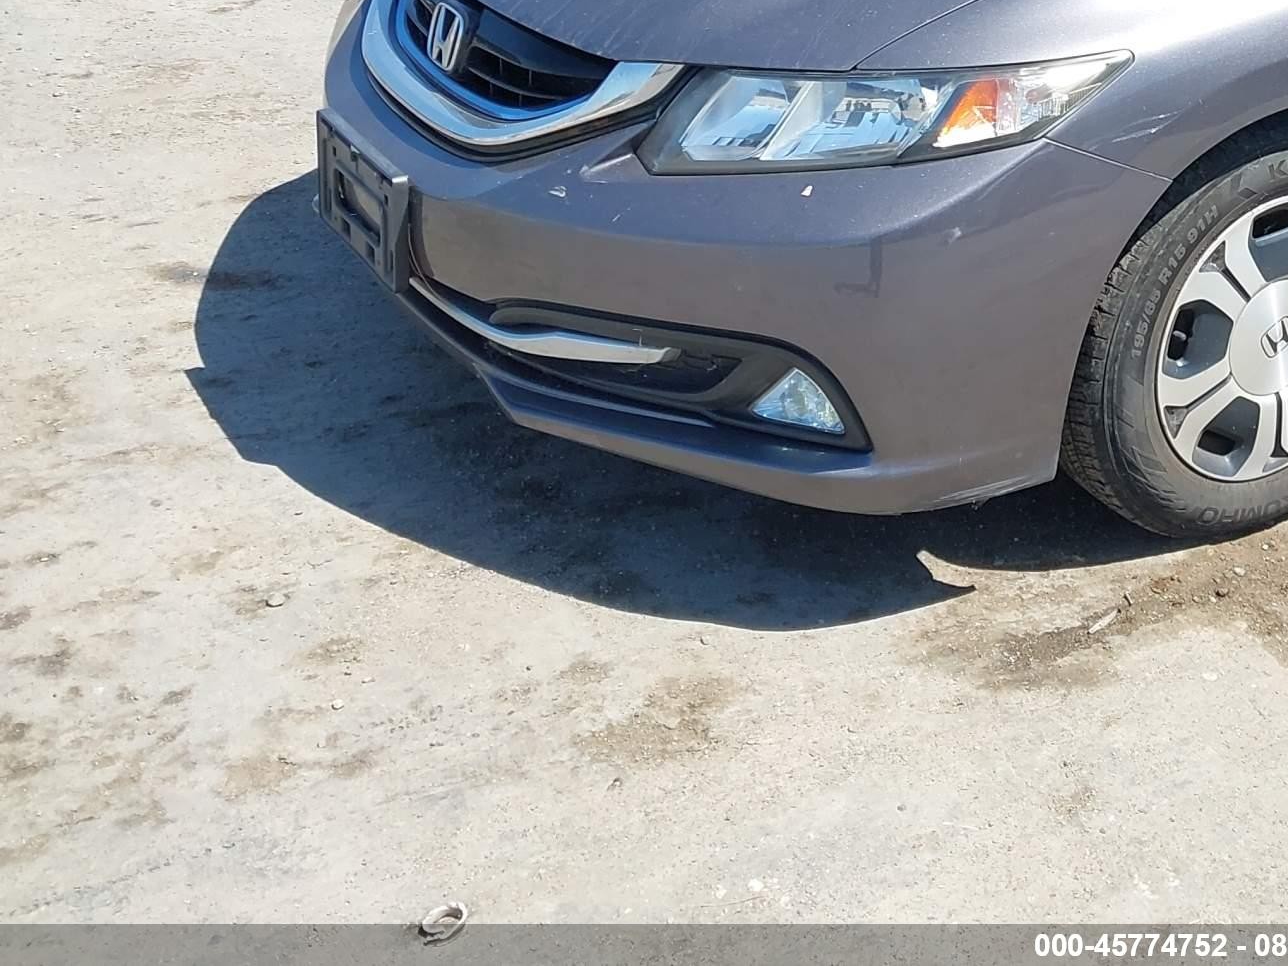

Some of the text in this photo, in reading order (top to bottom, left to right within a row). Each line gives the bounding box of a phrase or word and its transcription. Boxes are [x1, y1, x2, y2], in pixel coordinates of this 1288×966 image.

[1132, 203, 1219, 359] 195/65 R15 91H
